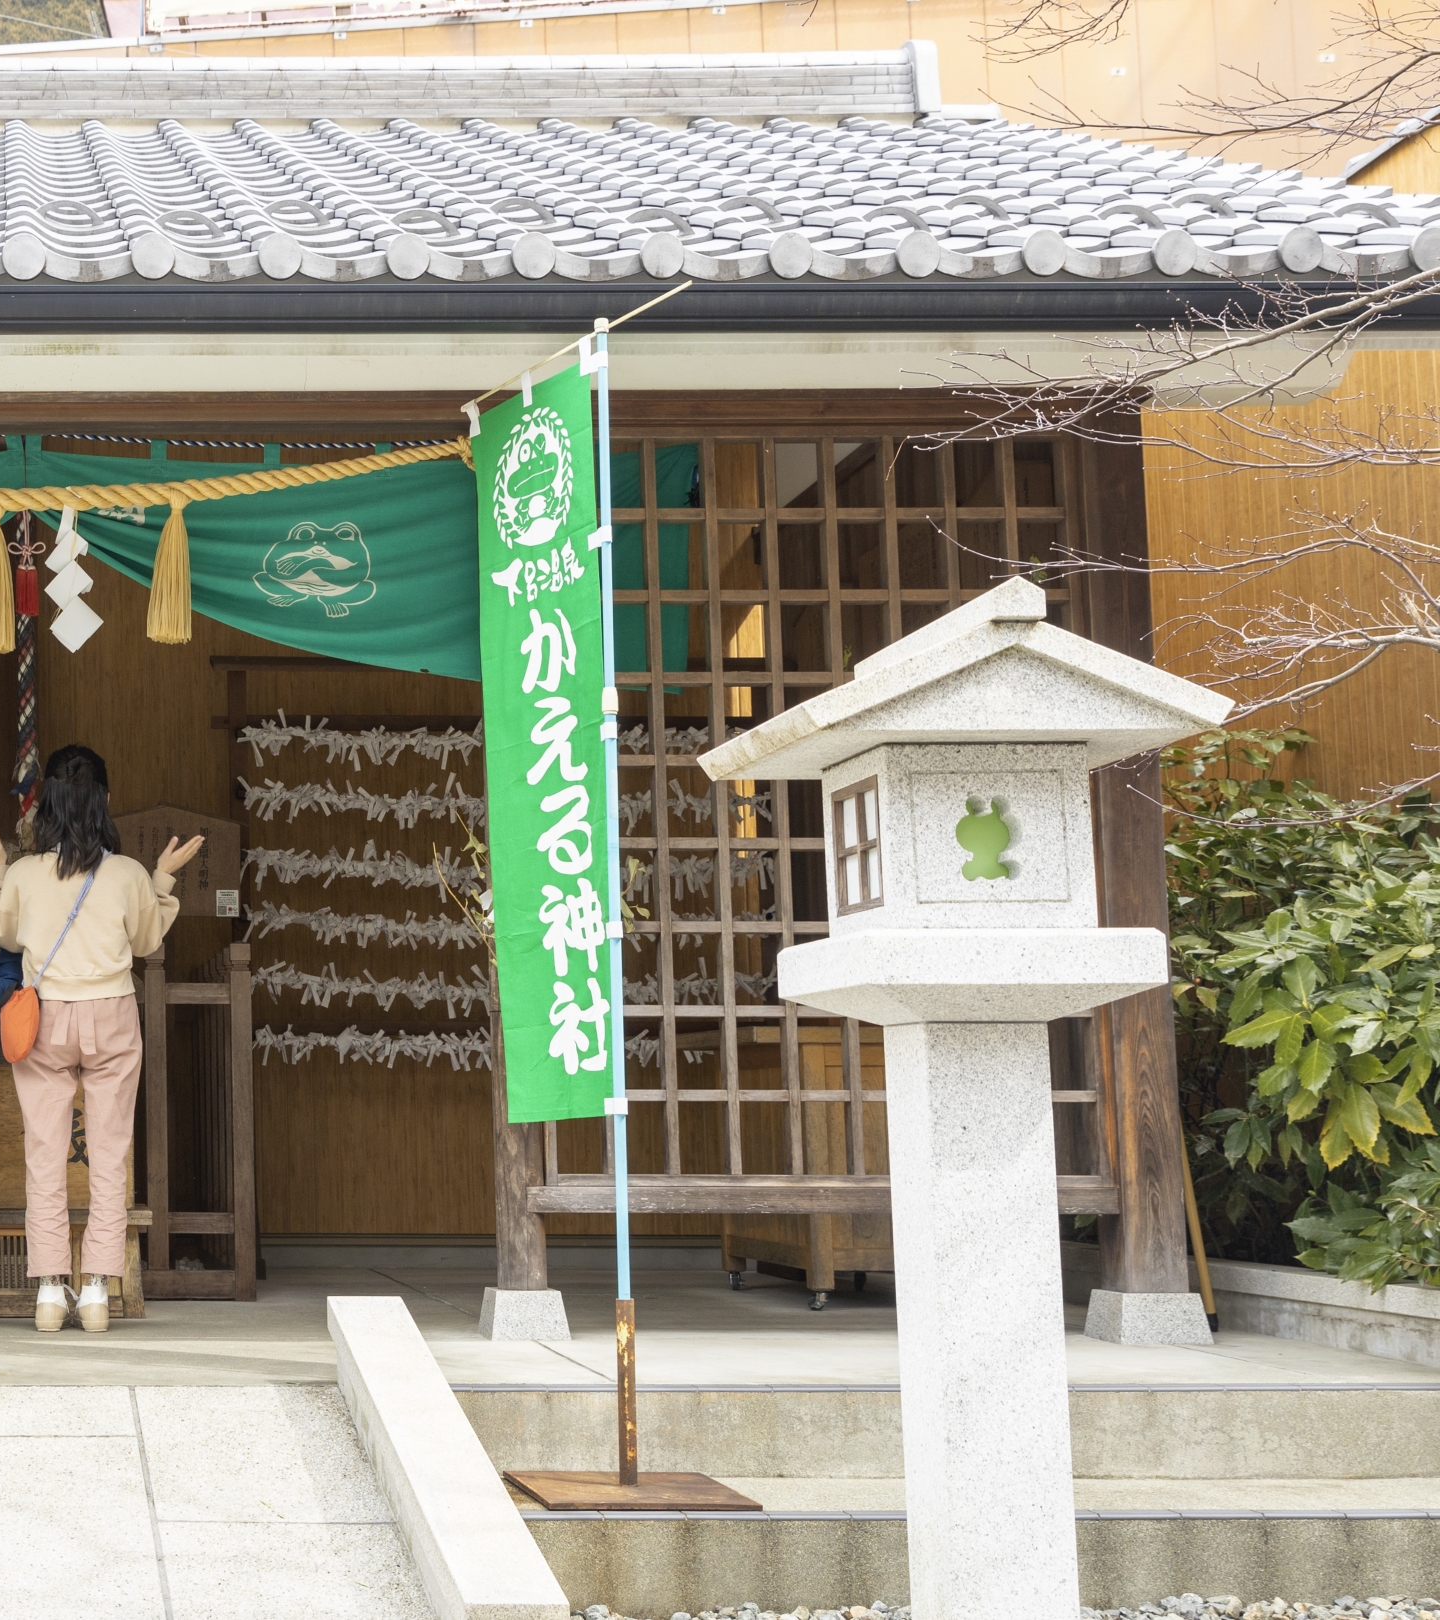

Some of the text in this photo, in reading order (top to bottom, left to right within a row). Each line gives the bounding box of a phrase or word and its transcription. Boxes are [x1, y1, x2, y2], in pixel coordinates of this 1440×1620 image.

[492, 537, 585, 607] 下呂温泉
[520, 608, 610, 1075] かえる神社
